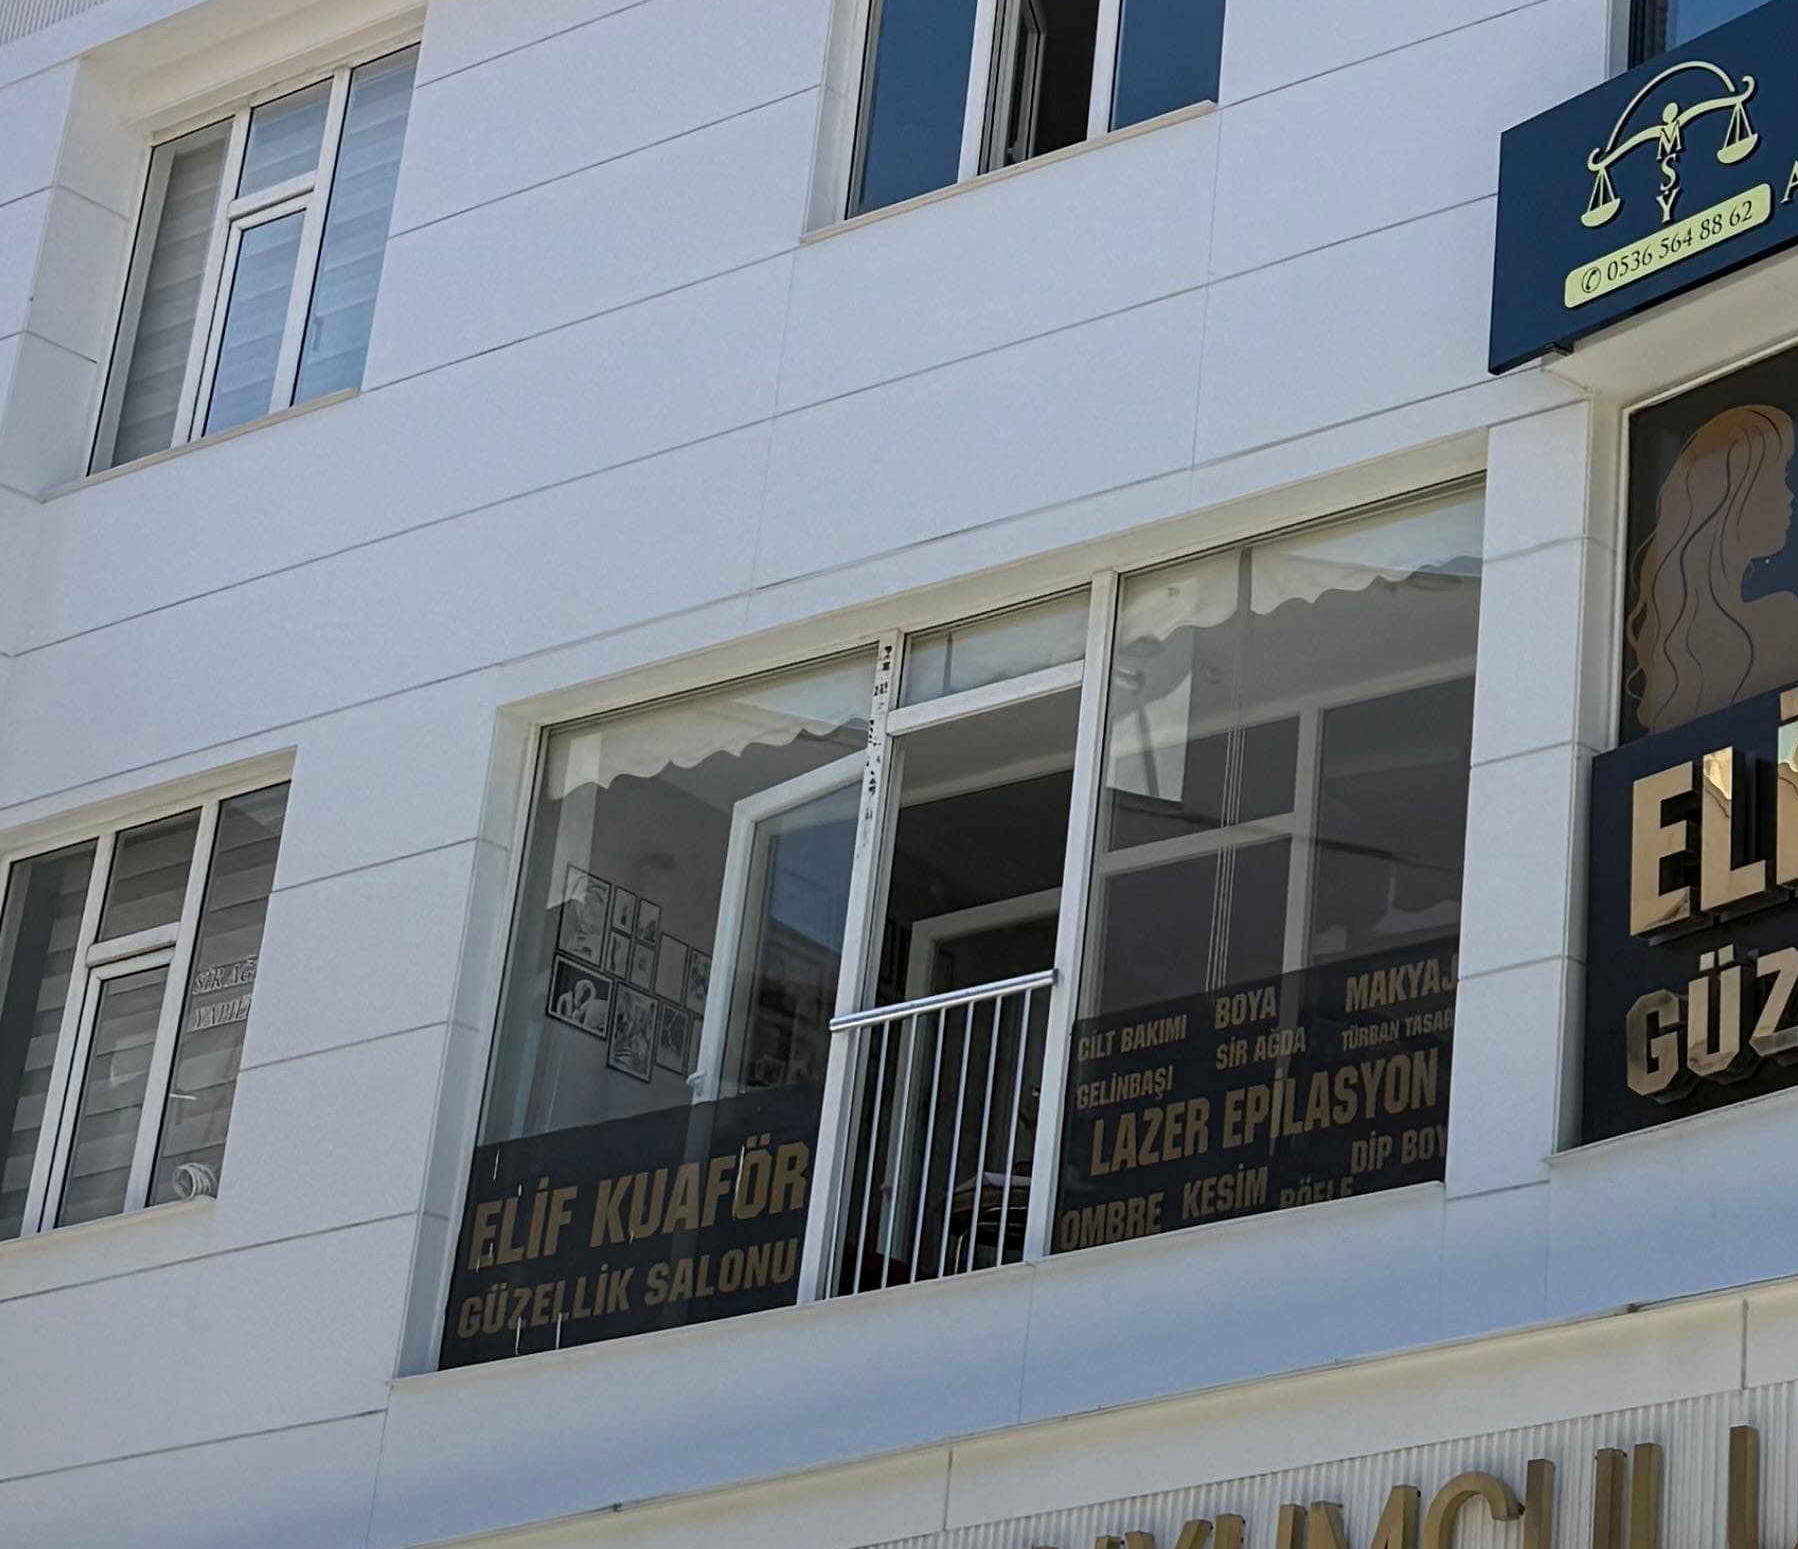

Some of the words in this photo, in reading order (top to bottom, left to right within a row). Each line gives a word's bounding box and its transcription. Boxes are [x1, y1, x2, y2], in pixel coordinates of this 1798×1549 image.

[1607, 247, 1653, 282] 0536
[1660, 228, 1693, 259] 564
[1699, 214, 1723, 241] 88
[1729, 200, 1754, 226] 62
[1214, 987, 1277, 1030] BOYA
[1345, 953, 1458, 1013] MAKYAJ
[1077, 1025, 1116, 1062] CİLT
[1120, 1015, 1187, 1053] BAKIMI
[1215, 1038, 1247, 1070] SİR
[1253, 1026, 1306, 1064] AĞDA
[1341, 1019, 1400, 1051] TÜRBAN
[1077, 1065, 1173, 1110] GELİNBAŞI
[1090, 1096, 1210, 1177] LAZER
[1222, 1048, 1440, 1149] EPİLASYON
[1351, 1130, 1393, 1174] DİP
[467, 1177, 578, 1271] ELİF
[589, 1132, 811, 1248] KUAFÖR
[1061, 1192, 1164, 1249] OMBRE
[1182, 1163, 1268, 1219] KESİM
[456, 1264, 634, 1339] GÜZELLİK
[643, 1237, 799, 1306] SALONU
